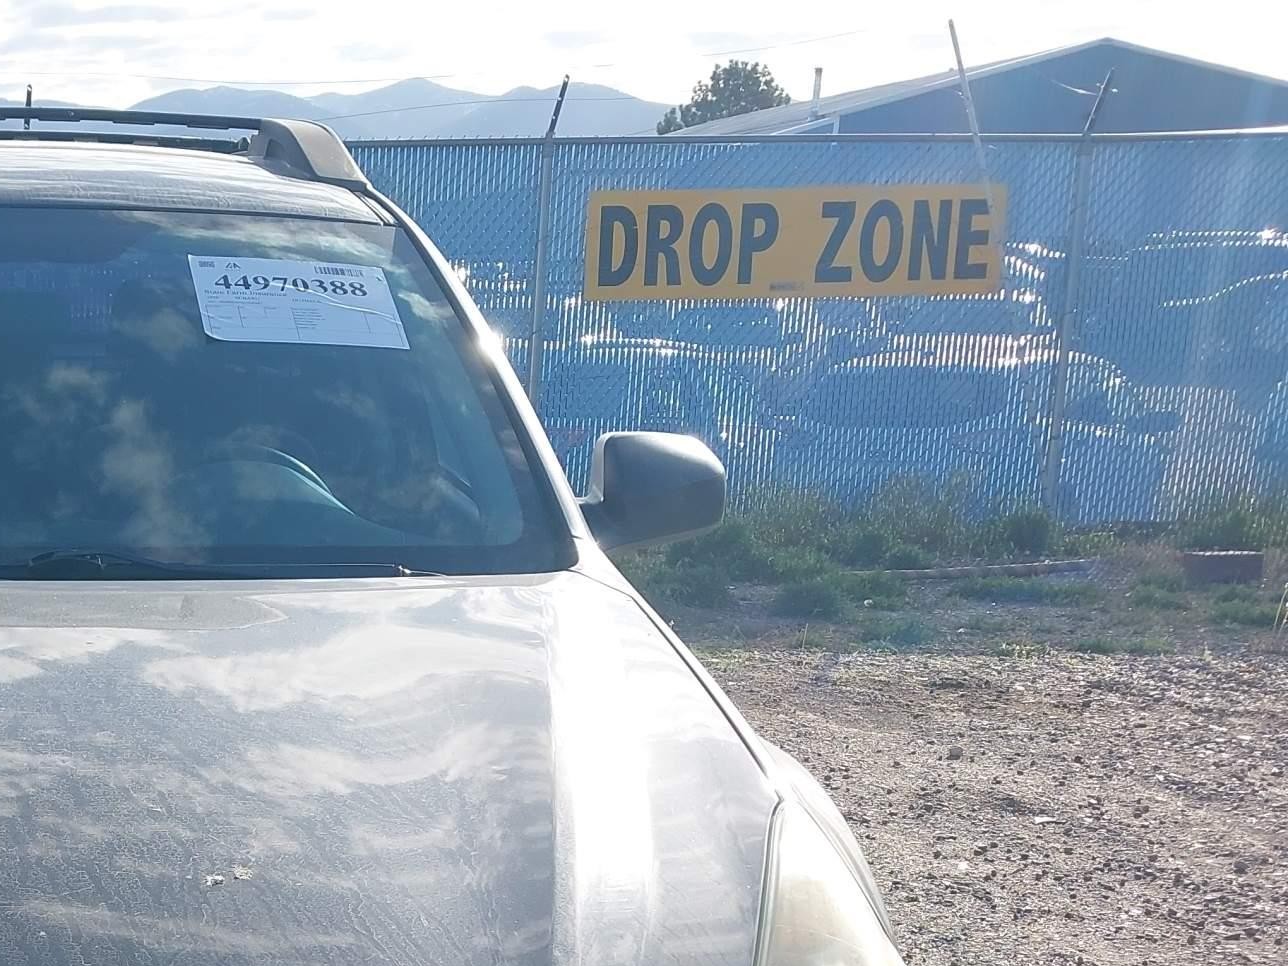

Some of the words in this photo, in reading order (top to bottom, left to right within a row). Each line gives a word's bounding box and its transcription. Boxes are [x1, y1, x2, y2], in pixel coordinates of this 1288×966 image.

[597, 202, 780, 287] DROP
[814, 198, 990, 284] ZONE
[214, 274, 368, 297] 44970388
